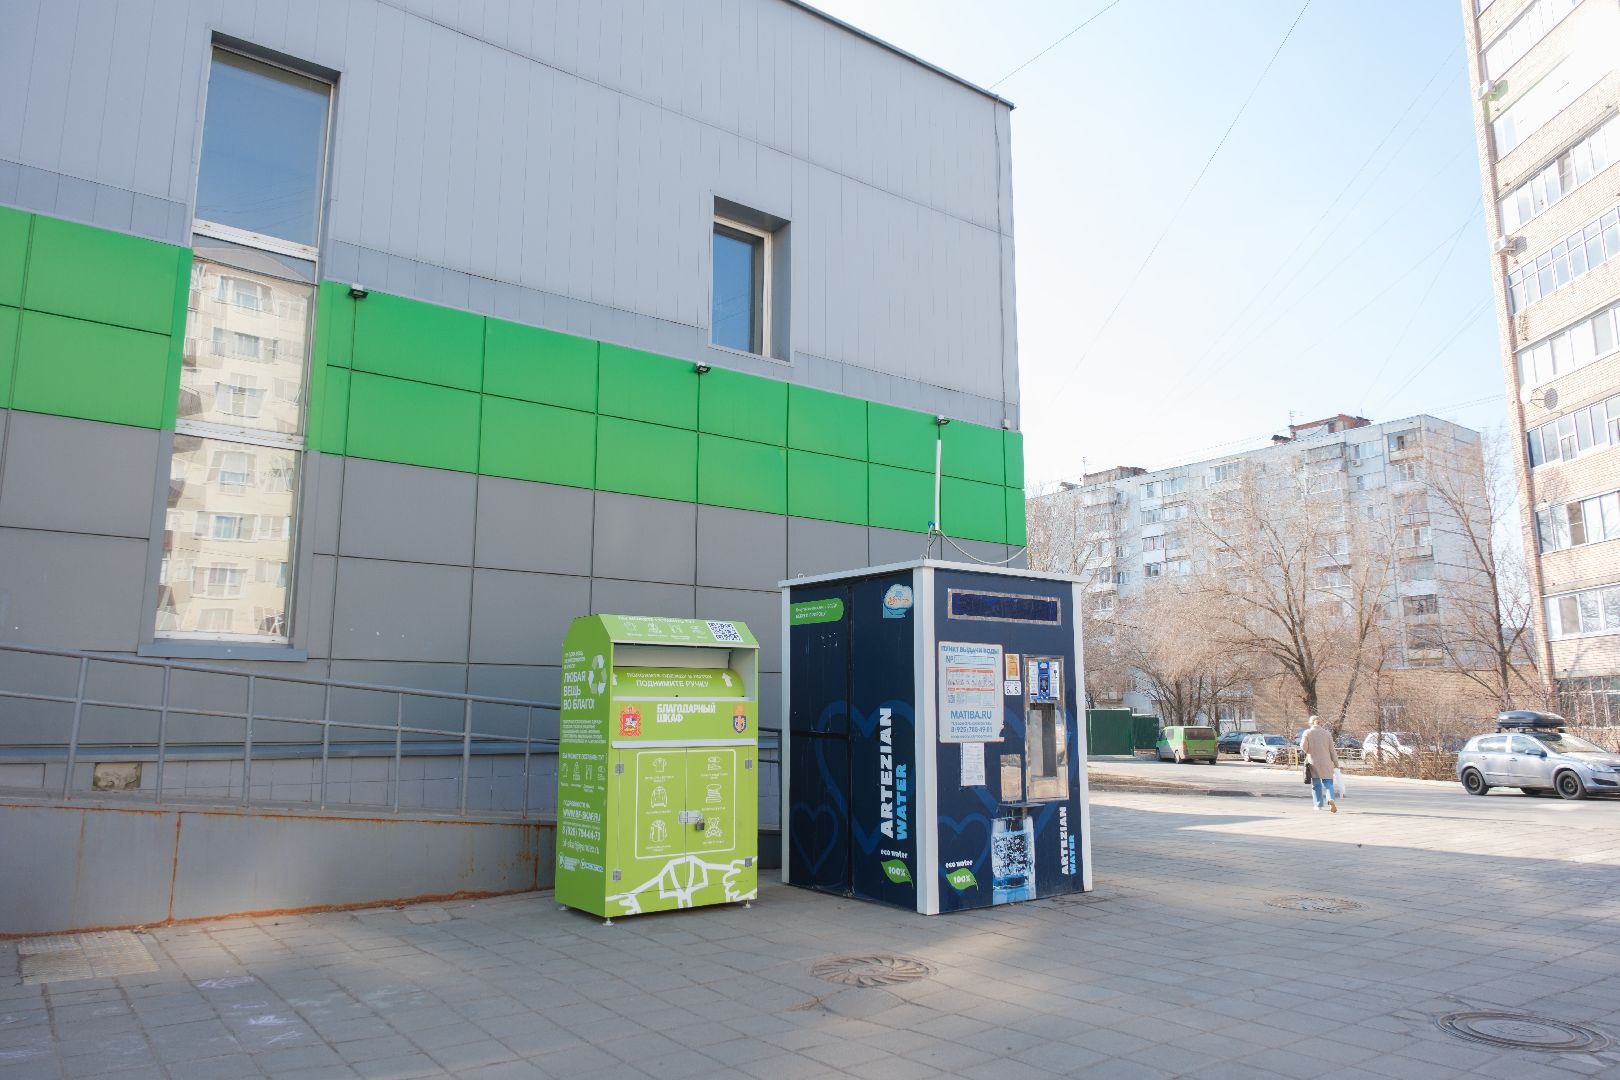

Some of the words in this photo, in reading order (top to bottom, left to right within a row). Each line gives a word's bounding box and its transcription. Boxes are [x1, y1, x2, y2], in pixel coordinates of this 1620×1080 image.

[563, 671, 586, 683] ЛЮБАЯ
[636, 679, 685, 688] ПОДНИМИТЕ
[686, 680, 709, 688] РУЧКУ
[563, 685, 582, 698] ВЕЩЬ
[563, 699, 572, 710] ВО
[656, 702, 716, 714] БЛАГОДАРНЫЙ
[656, 713, 683, 723] ШКАФ
[950, 710, 992, 719] MATIBA.RU
[879, 707, 894, 839] ARTEZIAN
[895, 763, 908, 841] WATER
[1059, 806, 1069, 875] ARTEZIAN
[891, 850, 908, 859] water
[1069, 834, 1077, 875] WATER
[956, 859, 973, 867] water
[888, 866, 906, 877] 100%
[953, 874, 971, 884] 100%
